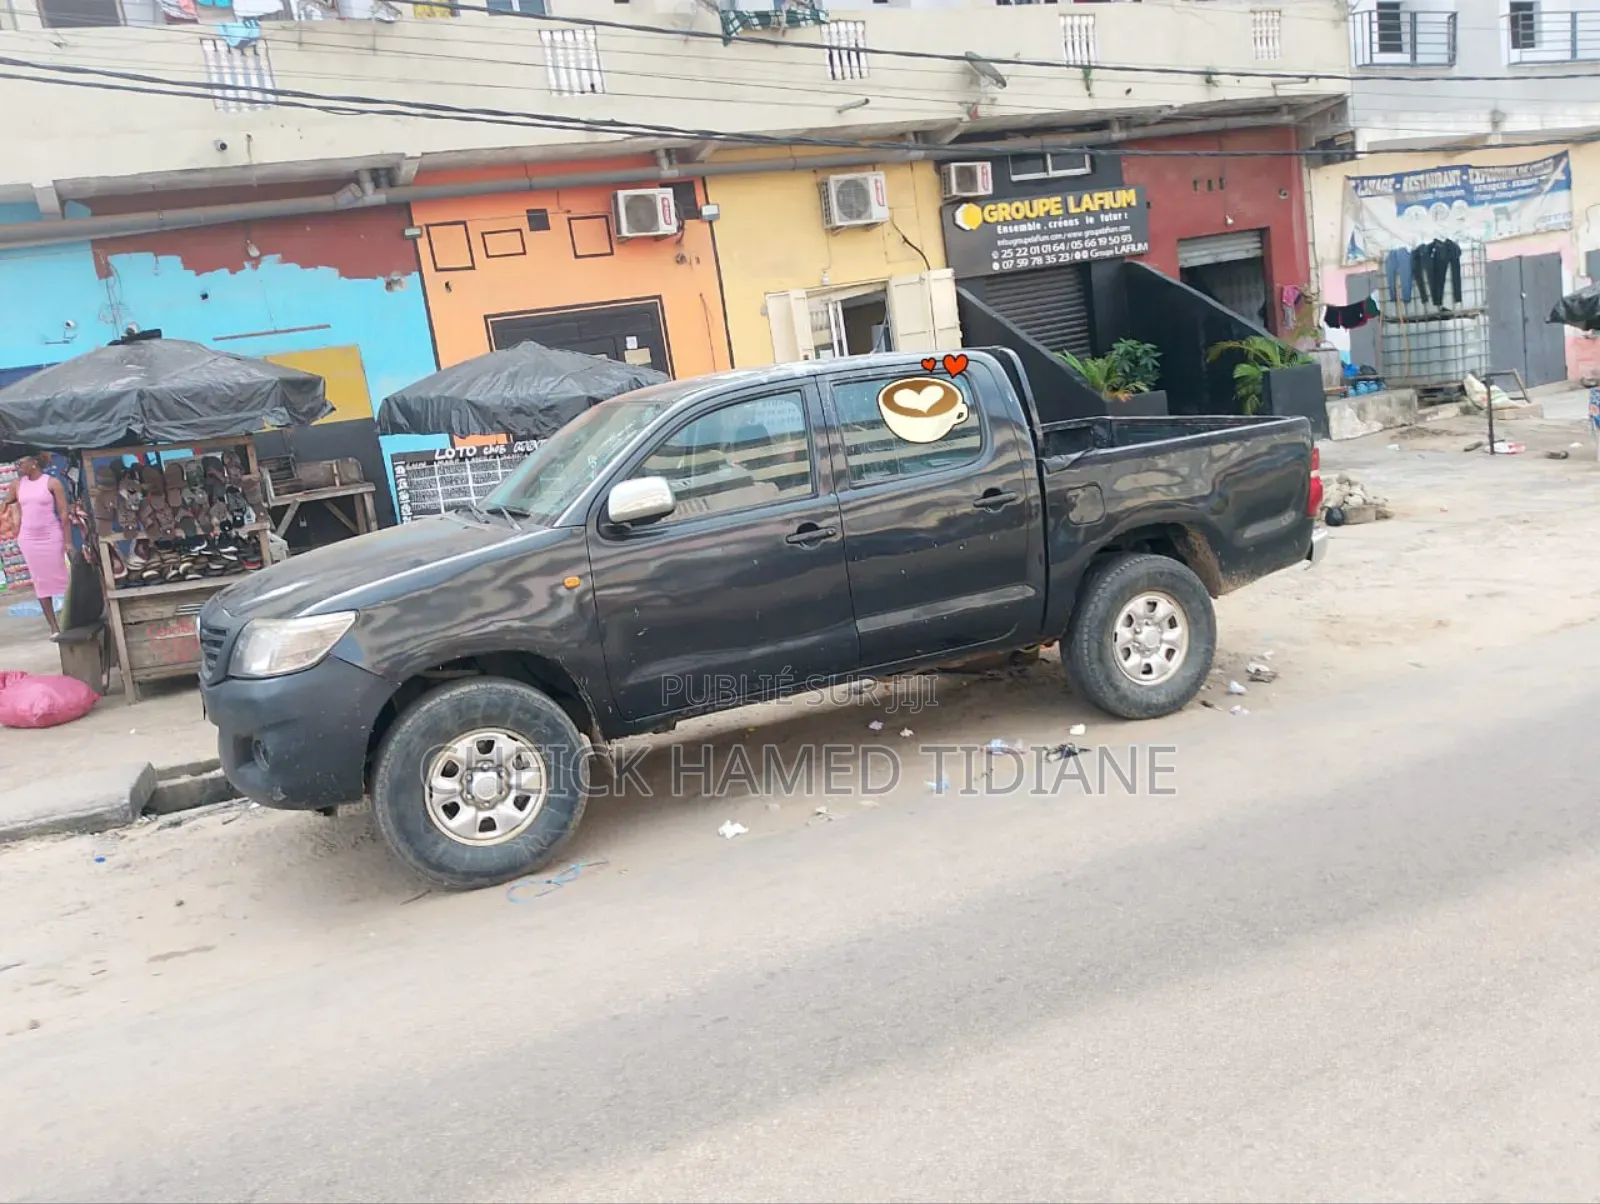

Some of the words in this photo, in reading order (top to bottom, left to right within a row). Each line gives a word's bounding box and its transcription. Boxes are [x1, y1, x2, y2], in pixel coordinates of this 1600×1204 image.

[983, 196, 1064, 223] GROUPE
[1067, 189, 1137, 214] LAFIUM
[1001, 248, 1013, 258] 25
[1015, 247, 1029, 257] 22
[1029, 245, 1041, 255] 01
[1041, 244, 1051, 254] 01
[1052, 242, 1065, 252] 64
[1070, 240, 1083, 250] 05
[1084, 238, 1097, 248] 66
[1108, 235, 1120, 245] 50
[1121, 234, 1132, 243] 93
[1002, 260, 1014, 270] 07
[1045, 254, 1056, 264] 35
[1058, 252, 1070, 262] 23
[1114, 242, 1149, 255] LAFIUM
[434, 446, 477, 460] LOTO
